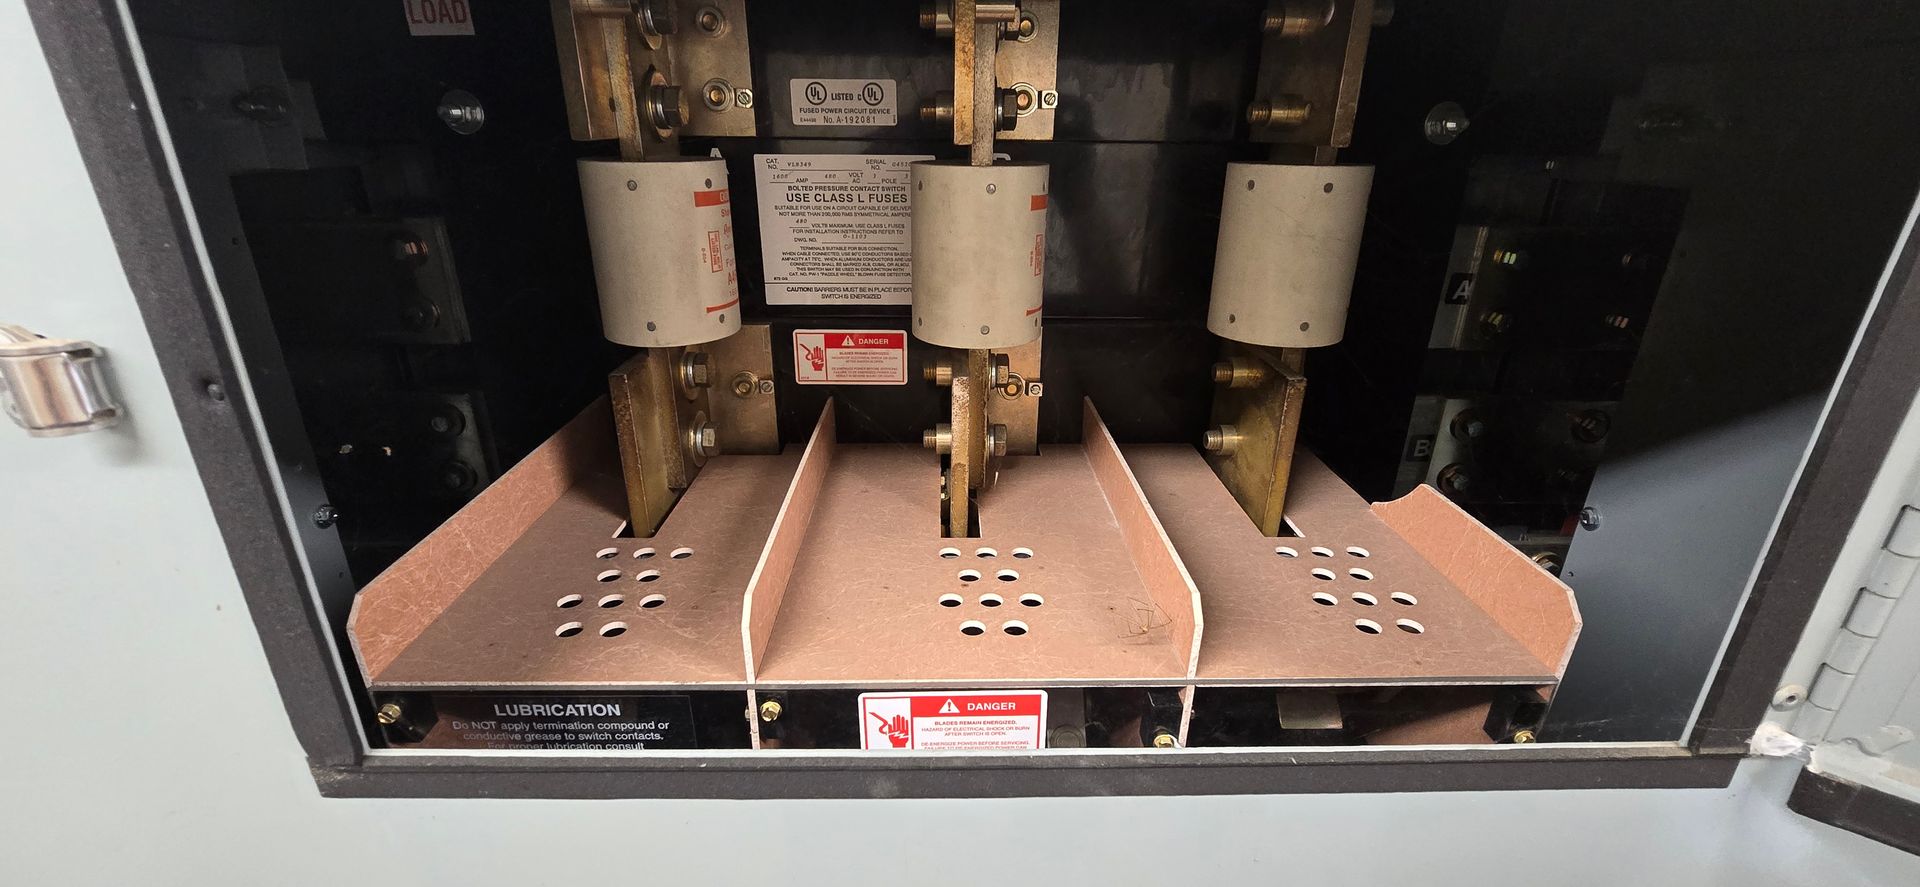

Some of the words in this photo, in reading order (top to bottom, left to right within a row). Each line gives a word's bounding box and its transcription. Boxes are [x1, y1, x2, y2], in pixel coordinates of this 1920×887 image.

[407, 0, 466, 23] LOAD
[787, 193, 810, 202] USE
[815, 193, 853, 202] CLASS
[858, 194, 864, 202] L
[869, 194, 907, 202] FUSES
[1453, 280, 1473, 300] A
[1414, 440, 1430, 457] B
[494, 704, 621, 716] LUBRICATION
[453, 721, 468, 730] Do
[472, 721, 496, 730] NOT
[501, 722, 529, 731] apply
[533, 721, 594, 730] termination
[598, 721, 654, 731] compound
[524, 734, 561, 742] grease
